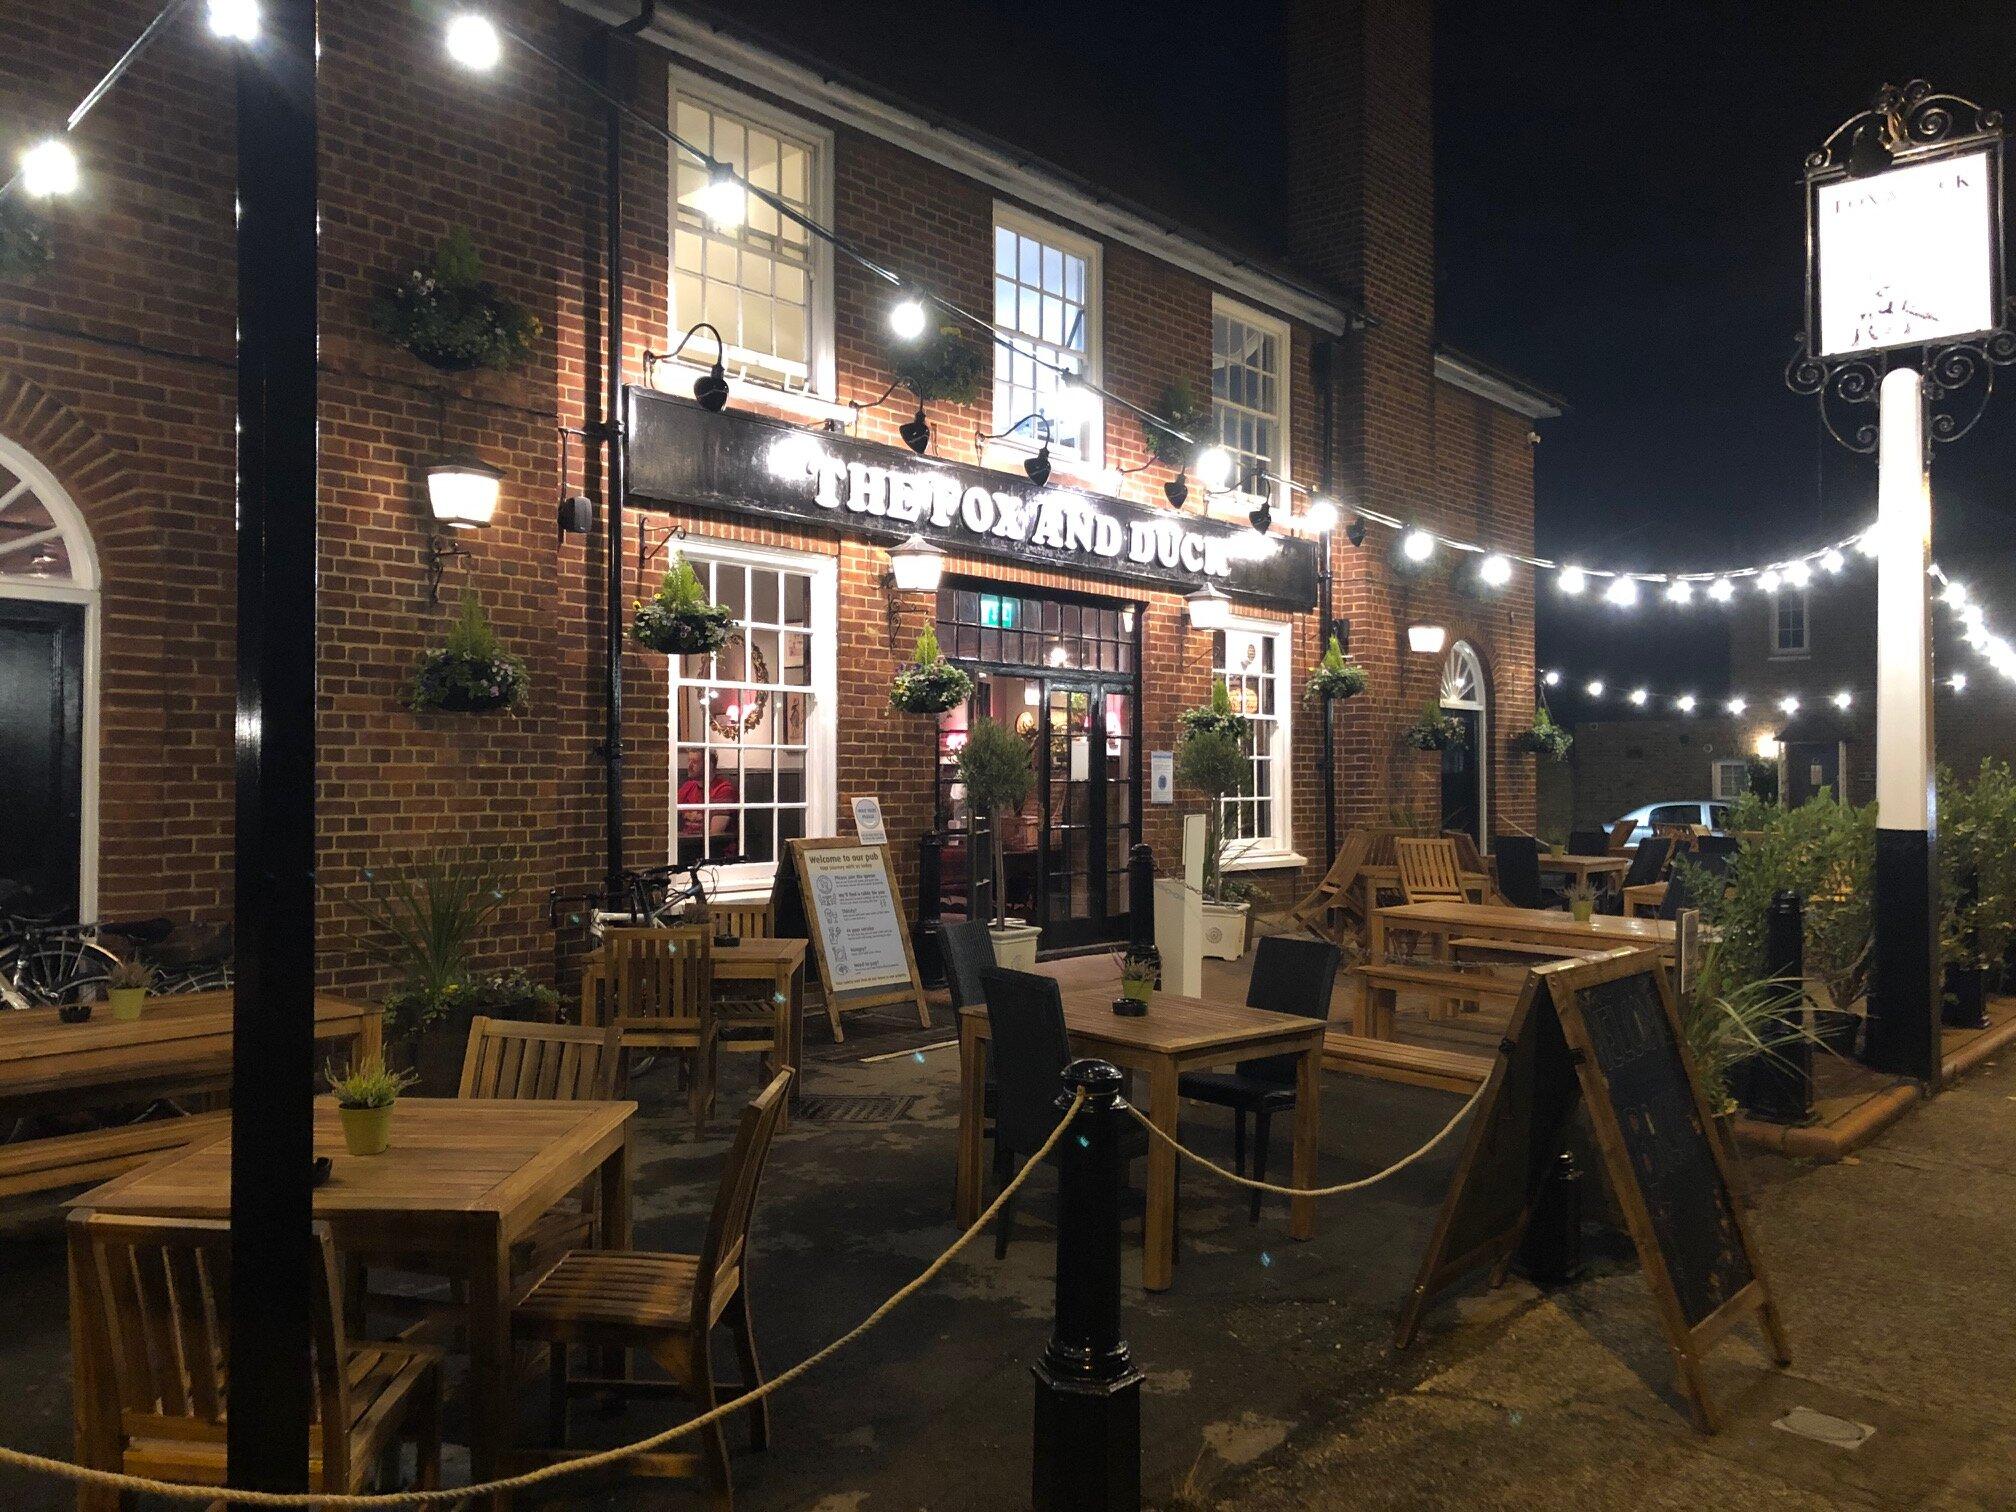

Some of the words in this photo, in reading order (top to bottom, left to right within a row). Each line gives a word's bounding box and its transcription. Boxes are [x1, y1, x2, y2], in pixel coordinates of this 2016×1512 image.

[806, 458, 921, 523] THE
[919, 471, 1027, 541] FOX
[1030, 491, 1123, 557] AND
[1128, 520, 1232, 577] DUCK
[809, 855, 842, 864] Welcome
[865, 852, 879, 862] pub
